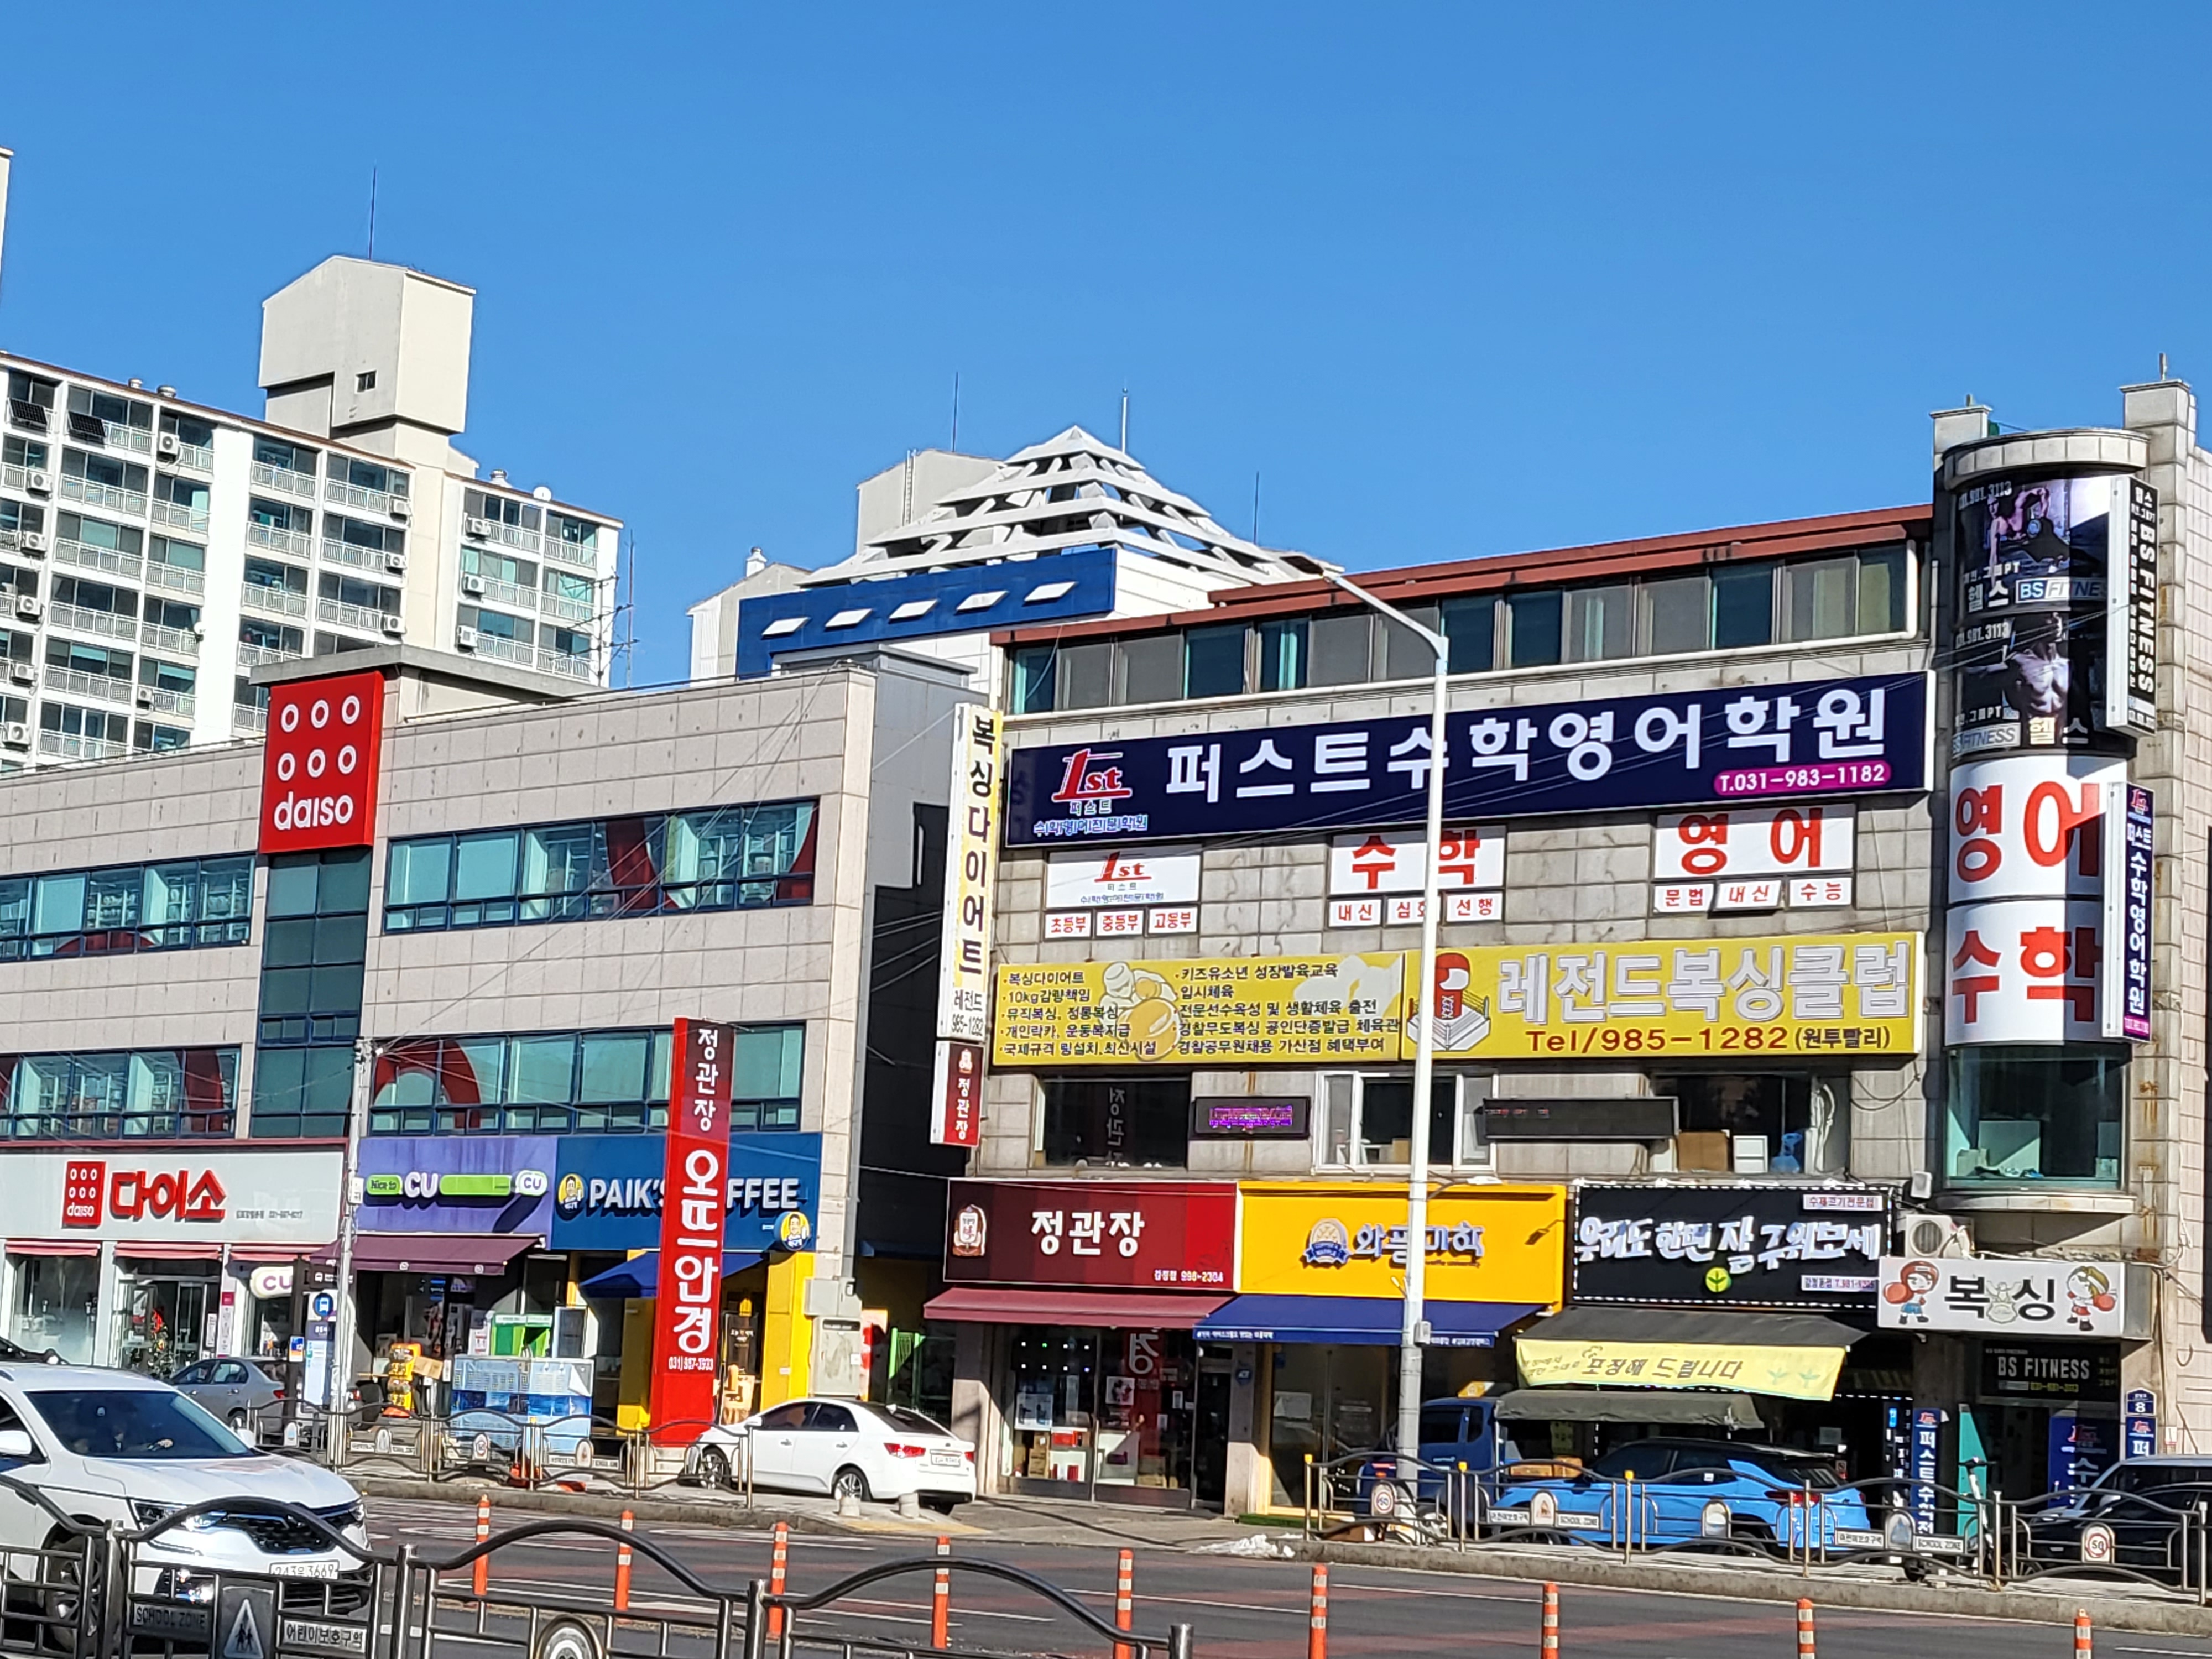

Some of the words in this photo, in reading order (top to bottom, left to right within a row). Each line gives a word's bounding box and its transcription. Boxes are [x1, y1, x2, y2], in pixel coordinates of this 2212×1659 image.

[2140, 523, 2155, 562] BS
[2020, 582, 2044, 599] BS
[2046, 580, 2101, 598] FITNE
[2138, 568, 2155, 693] FITNESS
[1166, 689, 1886, 802] 퍼스트수학영어학원
[1720, 764, 1886, 792] T.031-983-1182
[274, 791, 353, 830] daiso
[959, 715, 995, 975] 복싱다이어트
[1678, 808, 1823, 875] 영어
[1665, 888, 1704, 907] 문법
[1729, 885, 1770, 904] 내신
[1801, 881, 1843, 901] 수능
[1338, 904, 1372, 921] 내신
[1457, 898, 1493, 916] 선행
[1051, 916, 1086, 933] 초등부
[1103, 914, 1138, 931] 중등부
[1154, 912, 1191, 928] 고등부
[1009, 972, 1085, 985] 복싱다이어트
[1181, 967, 1248, 980] 키즈유소년
[1254, 963, 1338, 978] 성장발육교육
[1499, 941, 1910, 1024] 레전드복싱클럽
[1267, 1002, 1280, 1016] 및
[1286, 1000, 1342, 1016] 생활체육
[1005, 1043, 1055, 1056] 국제규격
[1279, 1039, 1321, 1053] 가산점
[1526, 1027, 1787, 1053] Tel/985-1282
[694, 1027, 718, 1131] 정관장
[956, 1078, 969, 1140] 정관장
[404, 1171, 439, 1198] CU
[524, 1177, 542, 1189] CU
[726, 1177, 800, 1209] FFEE
[111, 1170, 226, 1222] 다이소
[67, 1202, 95, 1217] daiso
[1031, 1211, 1145, 1258] 정관장
[263, 1275, 293, 1291] CU
[1944, 1275, 2055, 1321] 복싱
[1652, 1357, 1744, 1379] 드립니다
[1998, 1356, 2017, 1377] BS
[2024, 1358, 2090, 1380] FITNESS
[2135, 1402, 2146, 1413] 8
[136, 1606, 176, 1626] SCHOOL
[286, 1623, 363, 1647] 어린이보호구역
